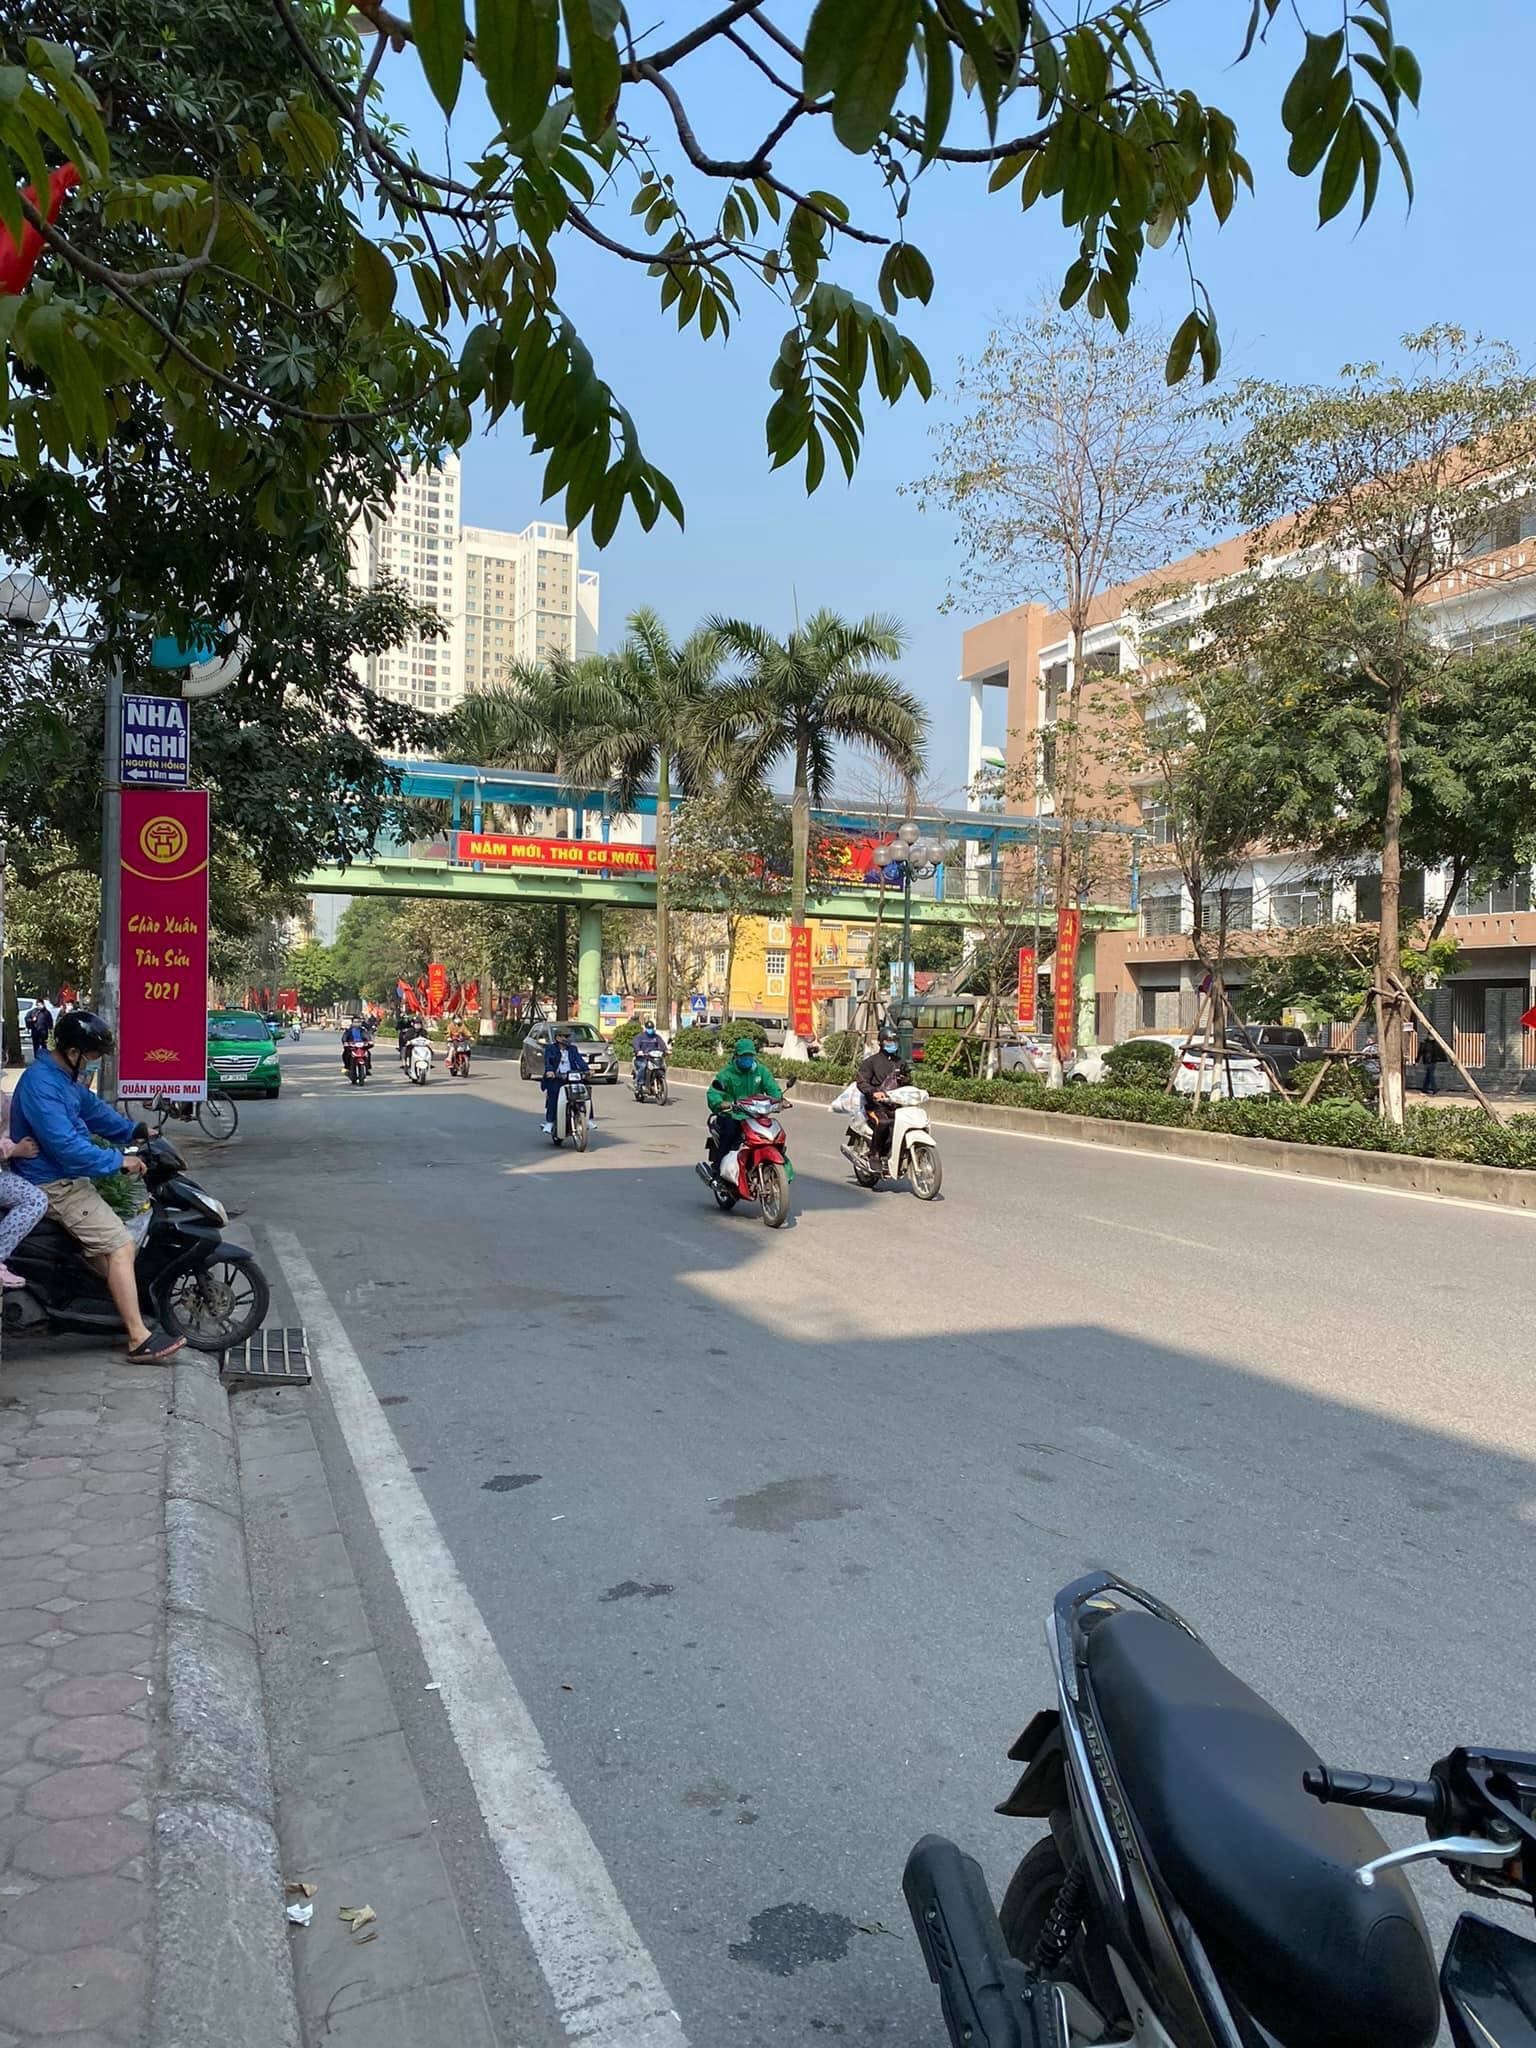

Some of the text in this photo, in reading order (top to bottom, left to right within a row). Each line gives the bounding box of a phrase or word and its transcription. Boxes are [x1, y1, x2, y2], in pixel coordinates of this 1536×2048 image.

[127, 702, 185, 729] NHÀ
[125, 730, 186, 758] NGHỈ
[470, 841, 507, 856] NĂM
[550, 847, 583, 862] THỜI
[587, 850, 608, 863] CƠ
[128, 914, 198, 934] Chào Xuân
[135, 948, 190, 967] Tân Sửu
[144, 982, 180, 1000] 2021
[122, 1084, 147, 1096] QUẬN
[183, 1085, 201, 1095] MAI
